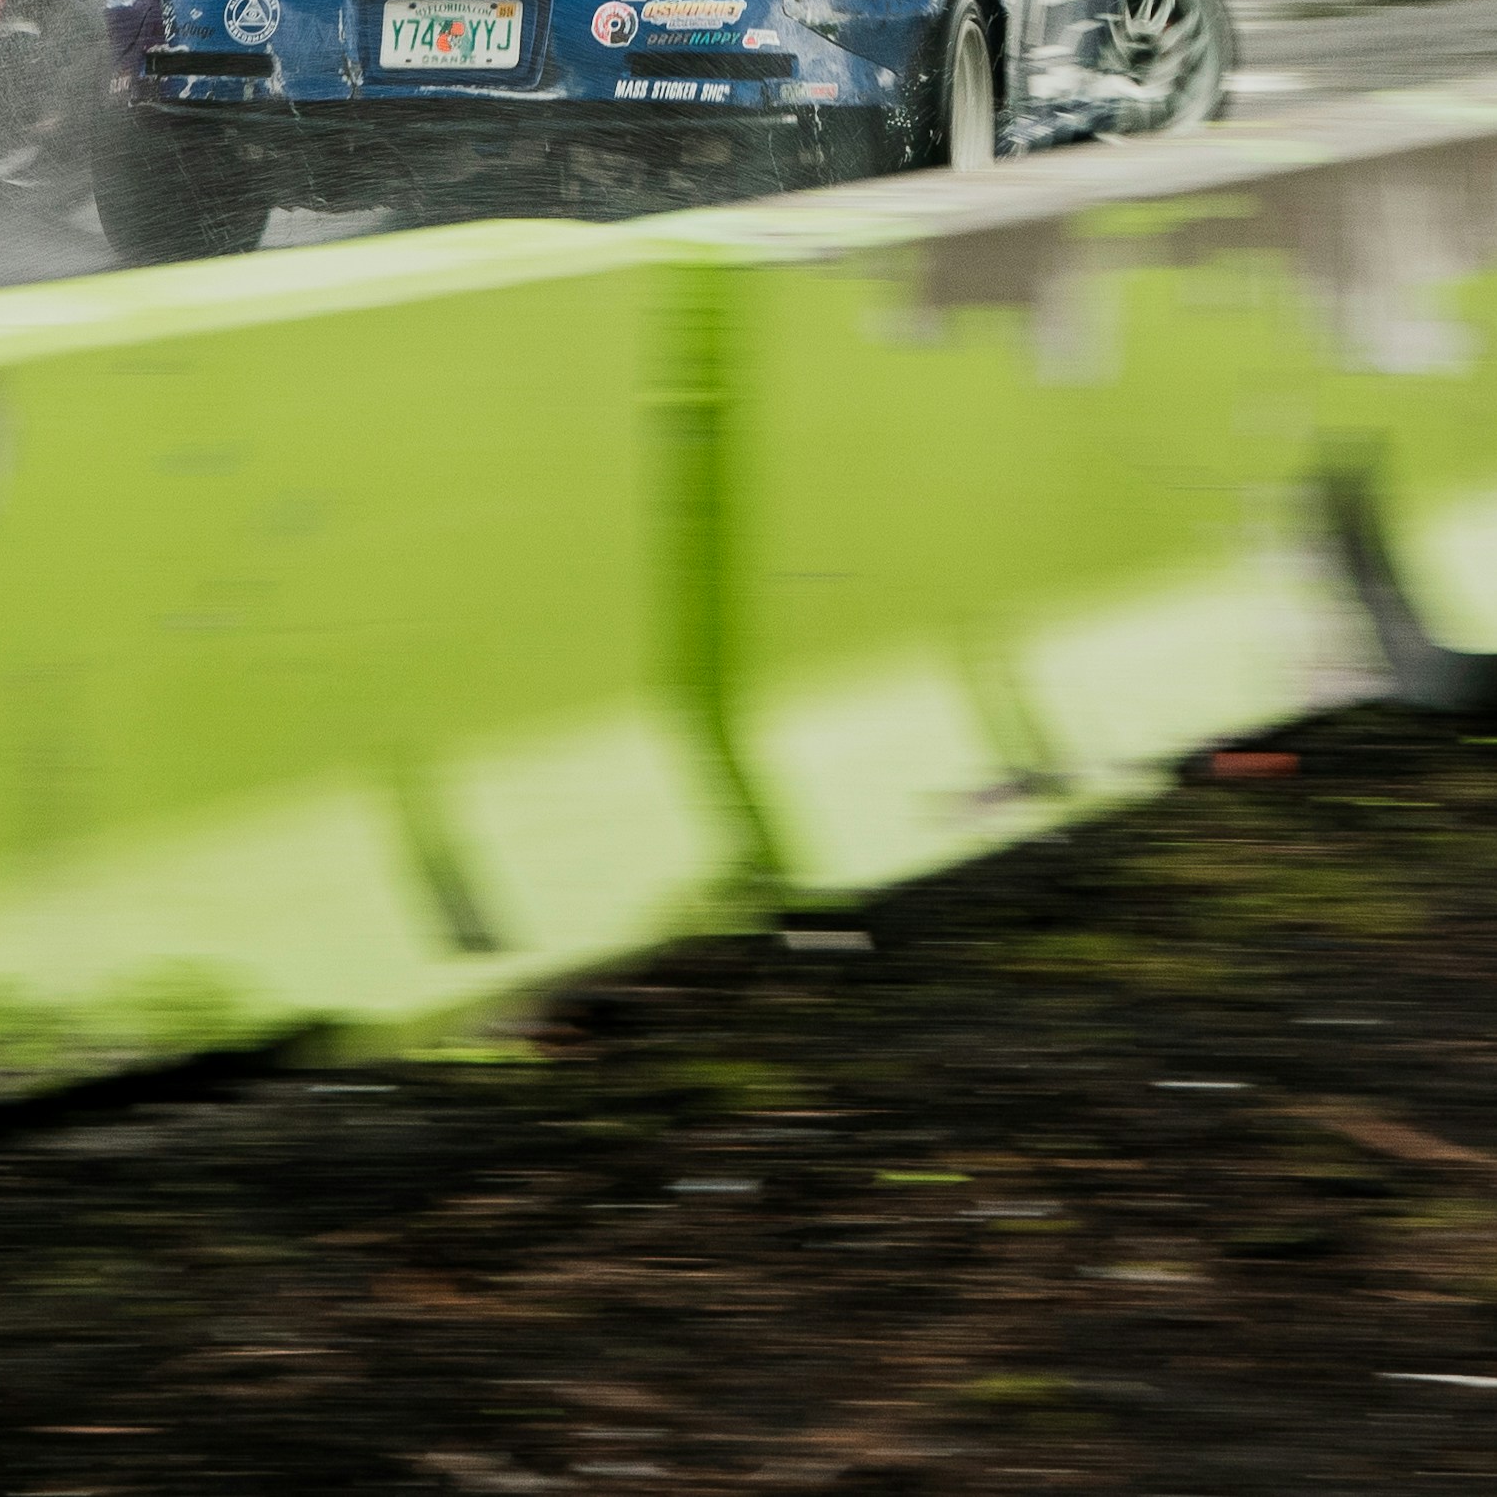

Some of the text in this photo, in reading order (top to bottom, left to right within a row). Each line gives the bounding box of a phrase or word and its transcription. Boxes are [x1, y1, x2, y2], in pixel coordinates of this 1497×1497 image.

[392, 19, 512, 52] Y74 YYJ
[421, 55, 476, 65] ORANGE
[614, 79, 649, 99] MASS
[651, 81, 698, 101] STICKER
